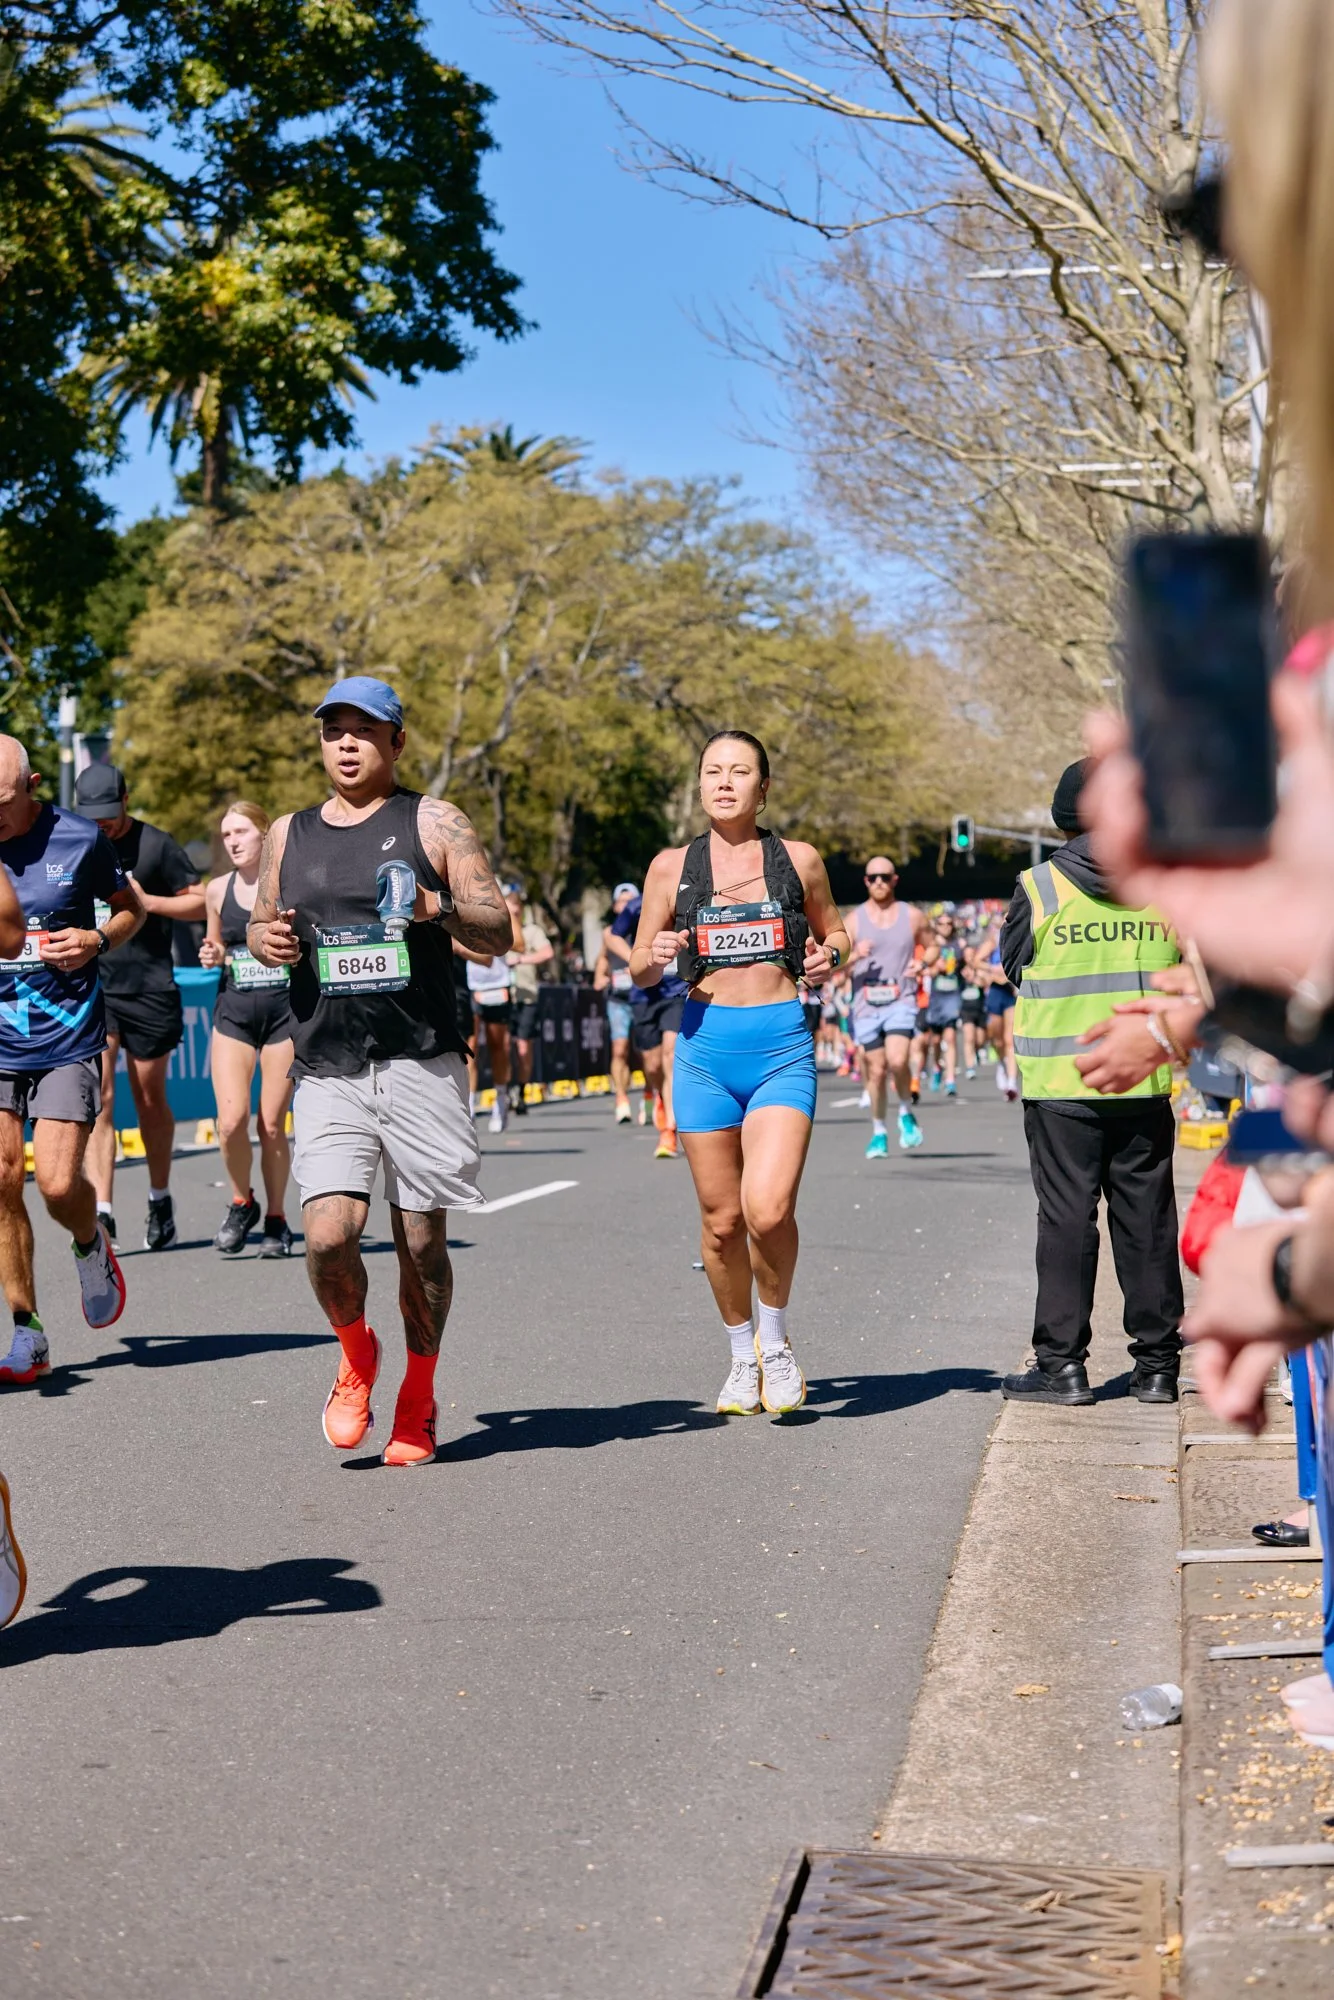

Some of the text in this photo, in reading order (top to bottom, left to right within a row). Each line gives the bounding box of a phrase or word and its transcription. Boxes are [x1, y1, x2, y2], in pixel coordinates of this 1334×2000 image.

[46, 863, 64, 874] tcs
[703, 912, 720, 923] tcs
[322, 933, 339, 946] tcs
[714, 931, 768, 950] 22421
[1054, 921, 1173, 946] SECURITY
[338, 955, 387, 975] 6848
